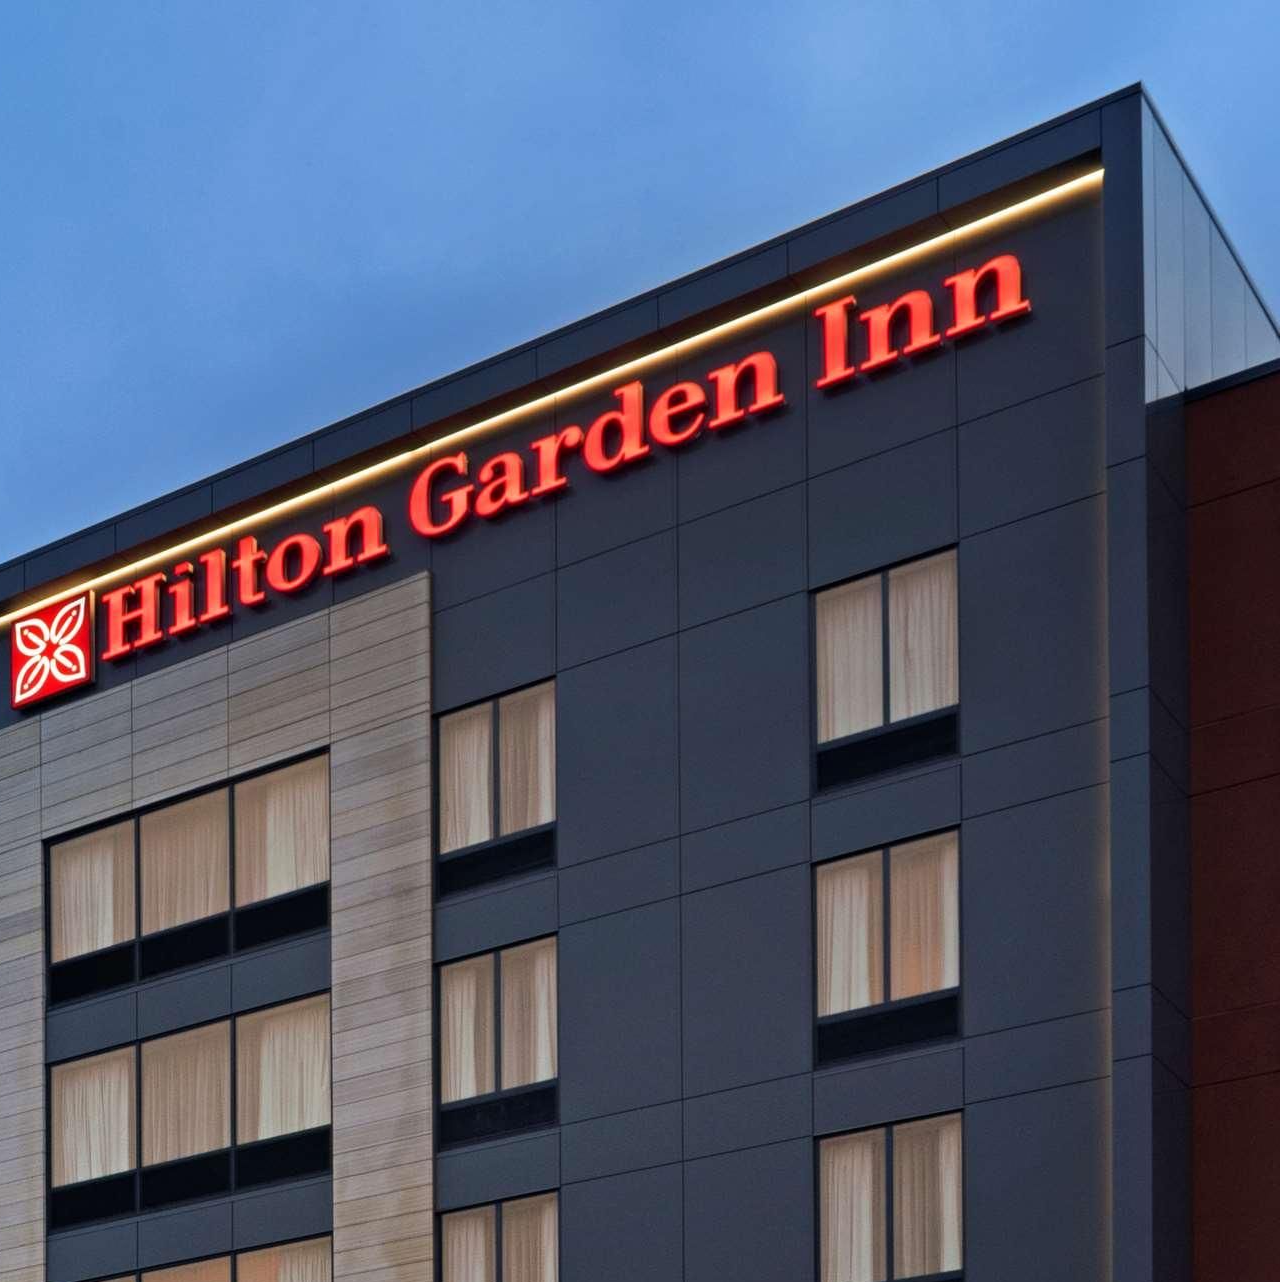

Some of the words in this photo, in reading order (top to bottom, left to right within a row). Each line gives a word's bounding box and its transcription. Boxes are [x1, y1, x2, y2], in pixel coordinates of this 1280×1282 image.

[101, 504, 391, 662] Hilton
[407, 349, 786, 539] Garden
[812, 251, 1033, 390] Inn
